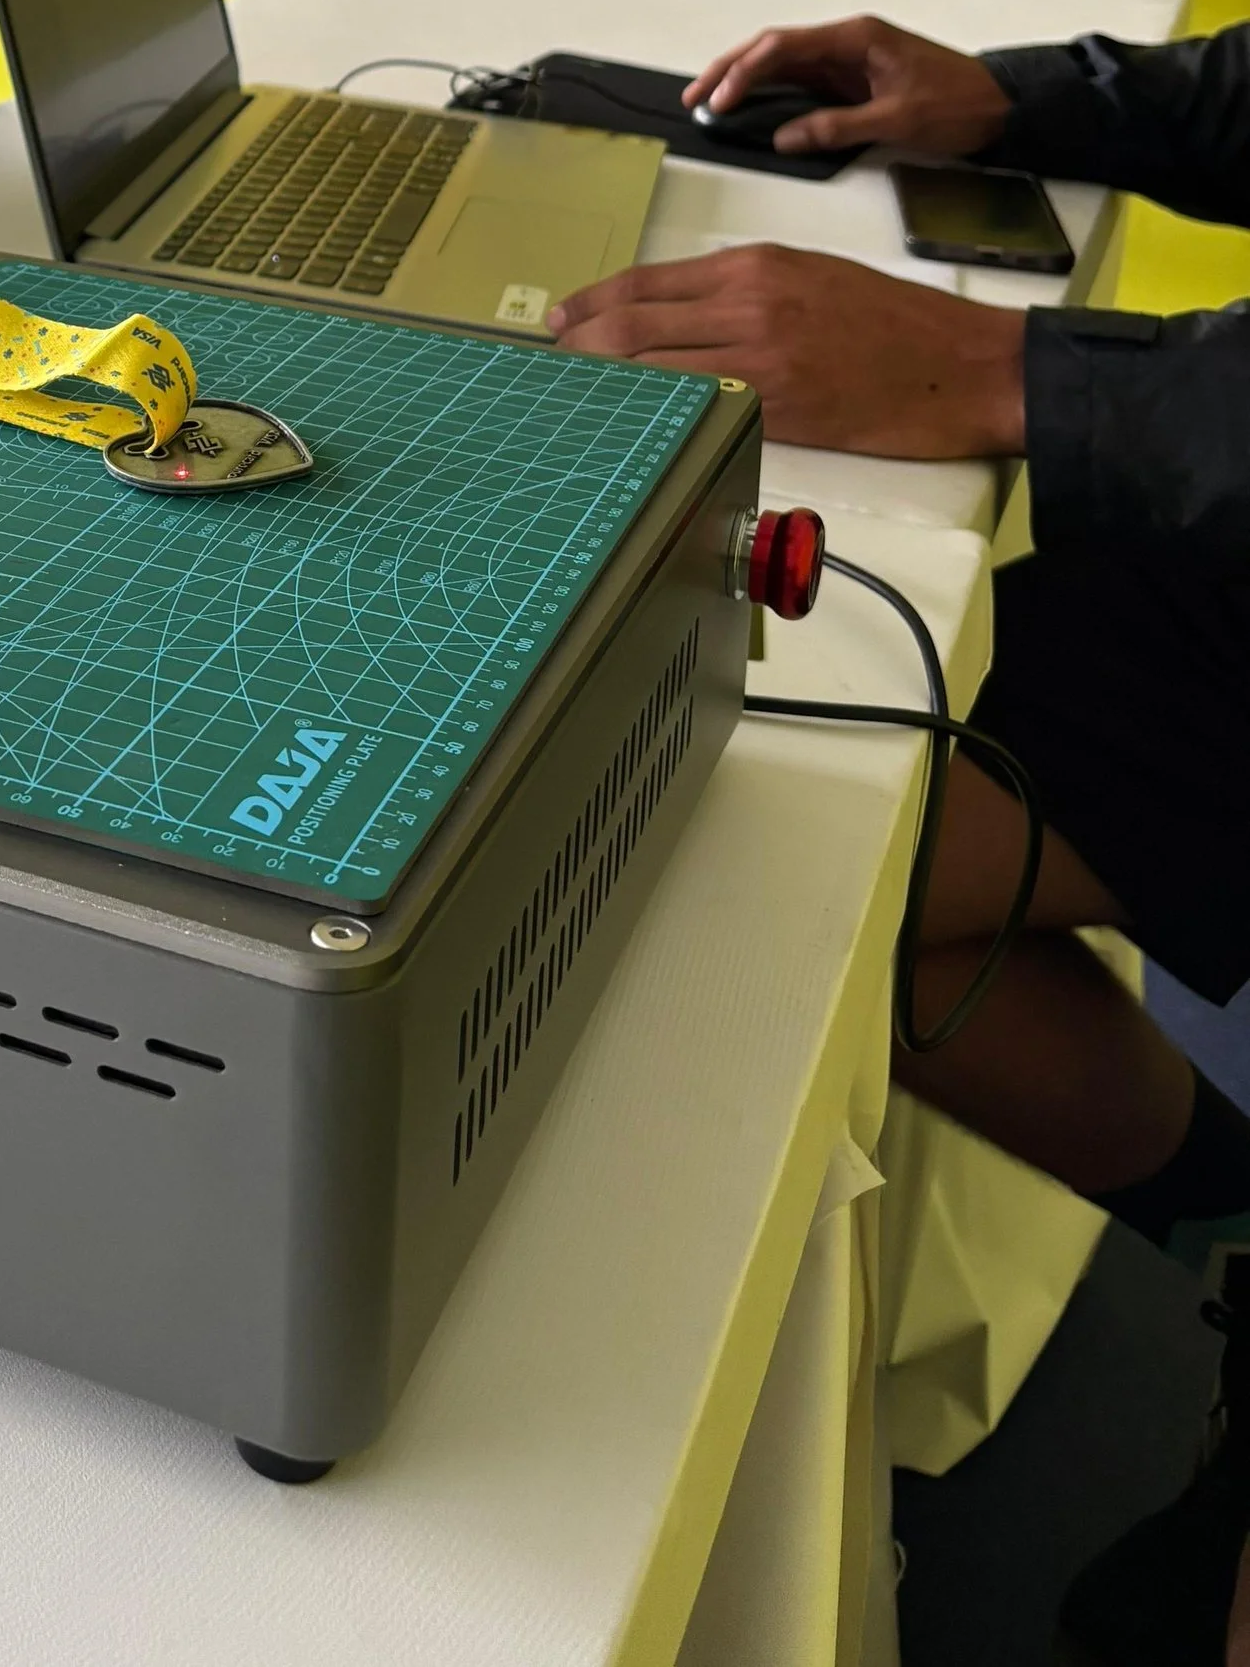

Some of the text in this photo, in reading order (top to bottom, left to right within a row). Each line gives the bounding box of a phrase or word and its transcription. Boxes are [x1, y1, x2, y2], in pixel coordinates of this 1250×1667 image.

[132, 327, 162, 350] VISA
[597, 522, 614, 533] 170
[573, 551, 593, 565] 150
[565, 568, 581, 581] 140
[554, 585, 570, 597] 130
[541, 602, 559, 615] 120
[529, 620, 547, 633] 110
[513, 637, 535, 652] 100
[503, 659, 521, 670] 90
[490, 679, 507, 690] 80
[476, 699, 494, 711] 70
[461, 721, 480, 732] 60
[443, 741, 465, 755] 50
[431, 765, 450, 777] 40
[287, 733, 384, 845] POSITIONING PLATE
[414, 788, 434, 800] 30
[10, 792, 32, 804] 60
[57, 804, 84, 818] 50
[109, 817, 133, 830] 40
[398, 812, 418, 826] 20
[160, 831, 183, 843] 30
[213, 843, 237, 857] 20
[381, 838, 400, 850] 10
[265, 857, 286, 870] 10
[361, 867, 381, 877] 0
[324, 873, 339, 885] 0
